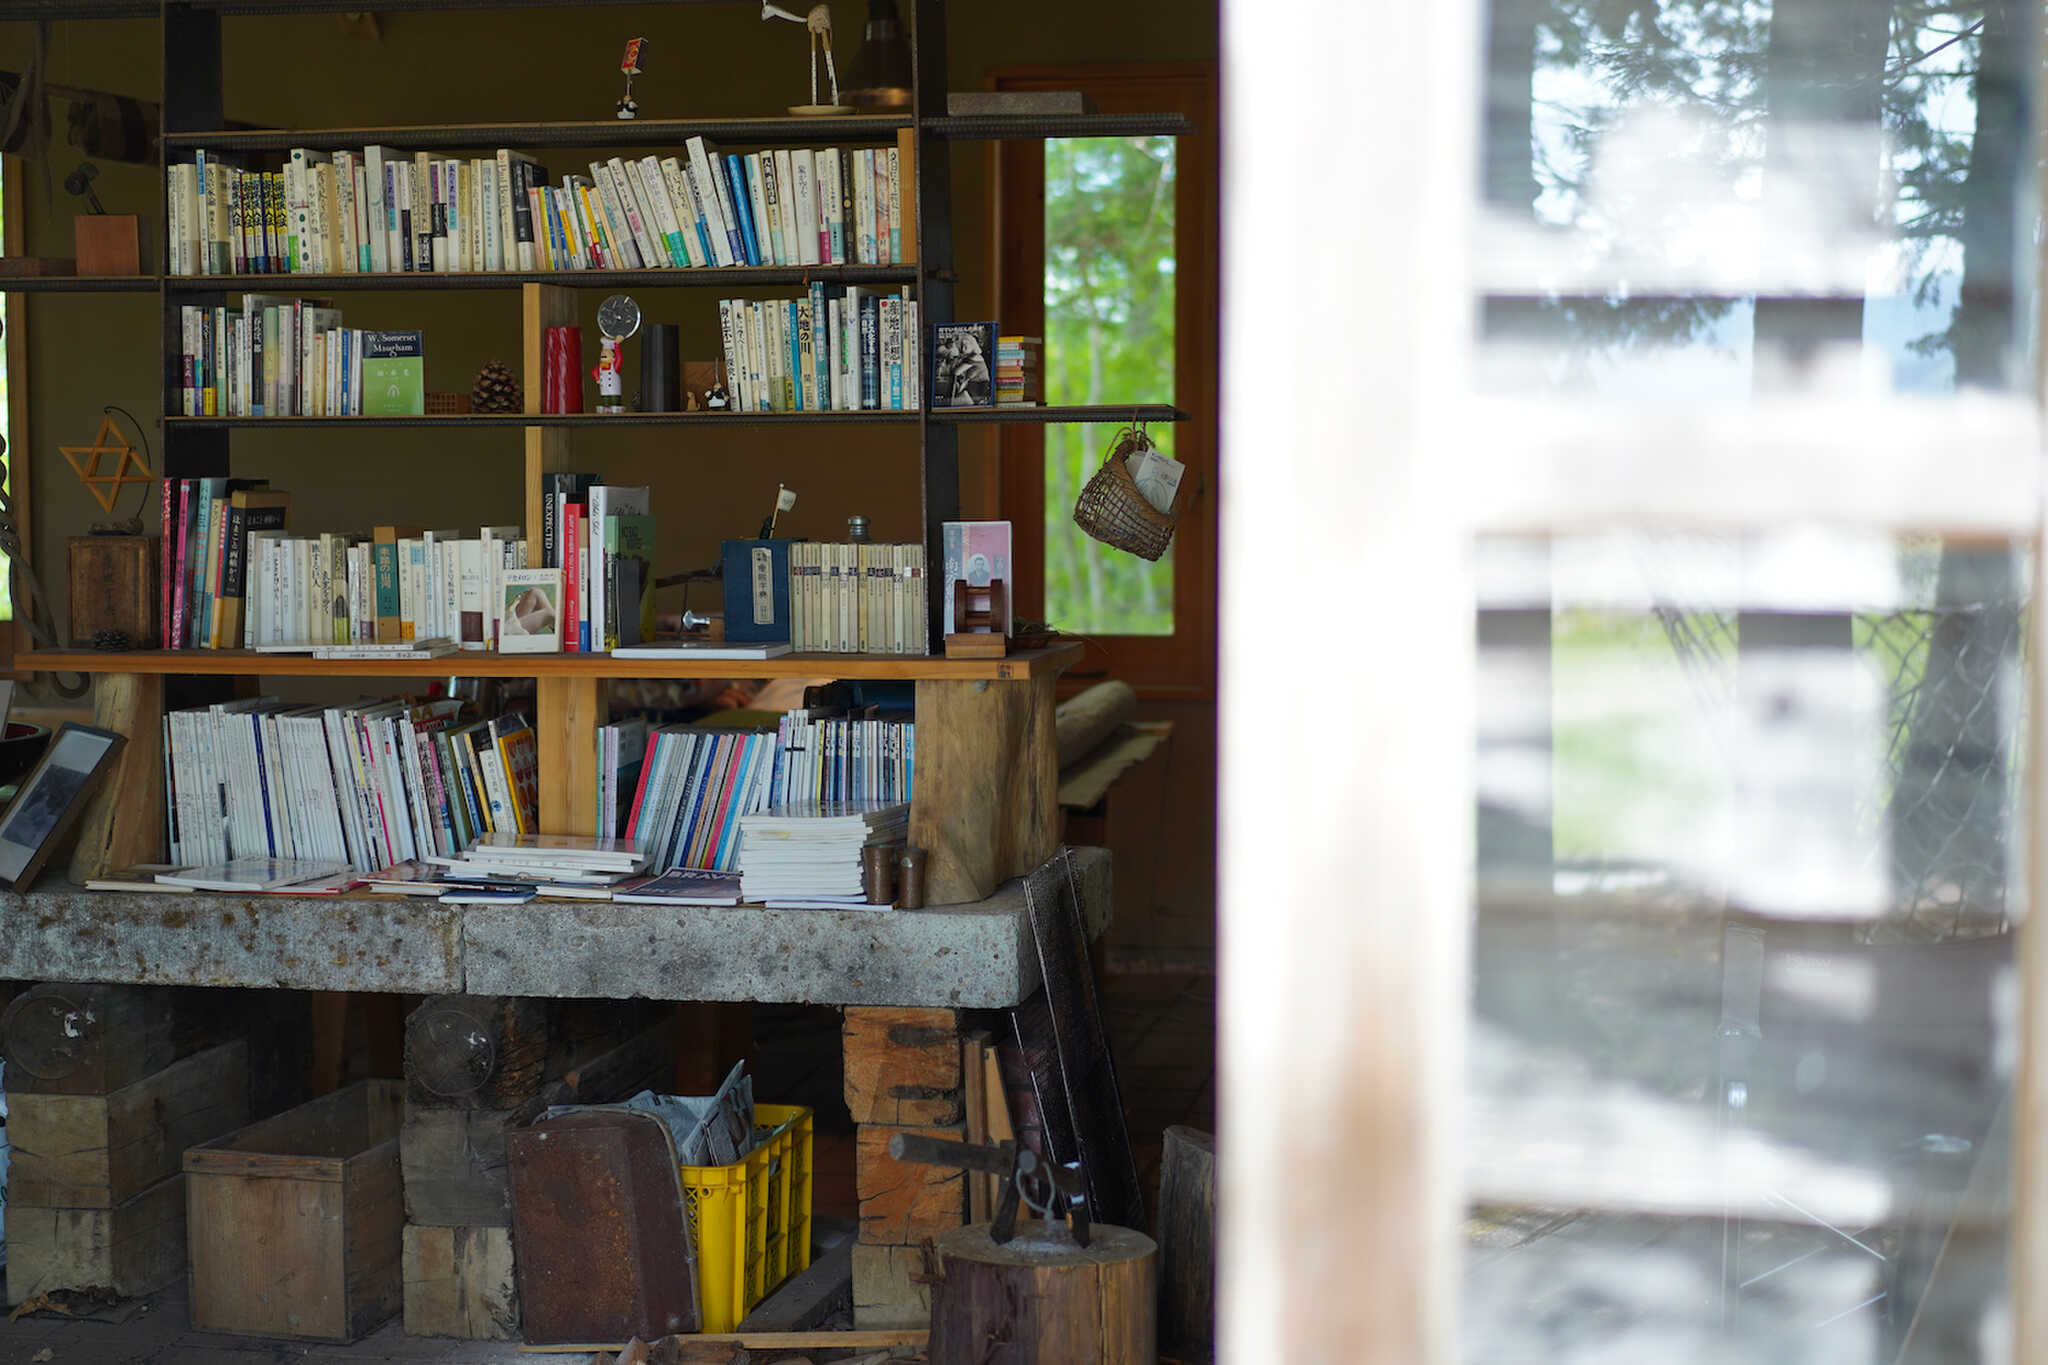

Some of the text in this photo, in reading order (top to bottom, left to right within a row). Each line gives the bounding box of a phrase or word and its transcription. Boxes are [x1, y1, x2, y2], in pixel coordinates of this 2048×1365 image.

[368, 334, 417, 342] W. Somerset
[799, 306, 811, 354] 大地の川
[373, 344, 414, 357] Maugham
[545, 493, 554, 550] UNEXPECTED
